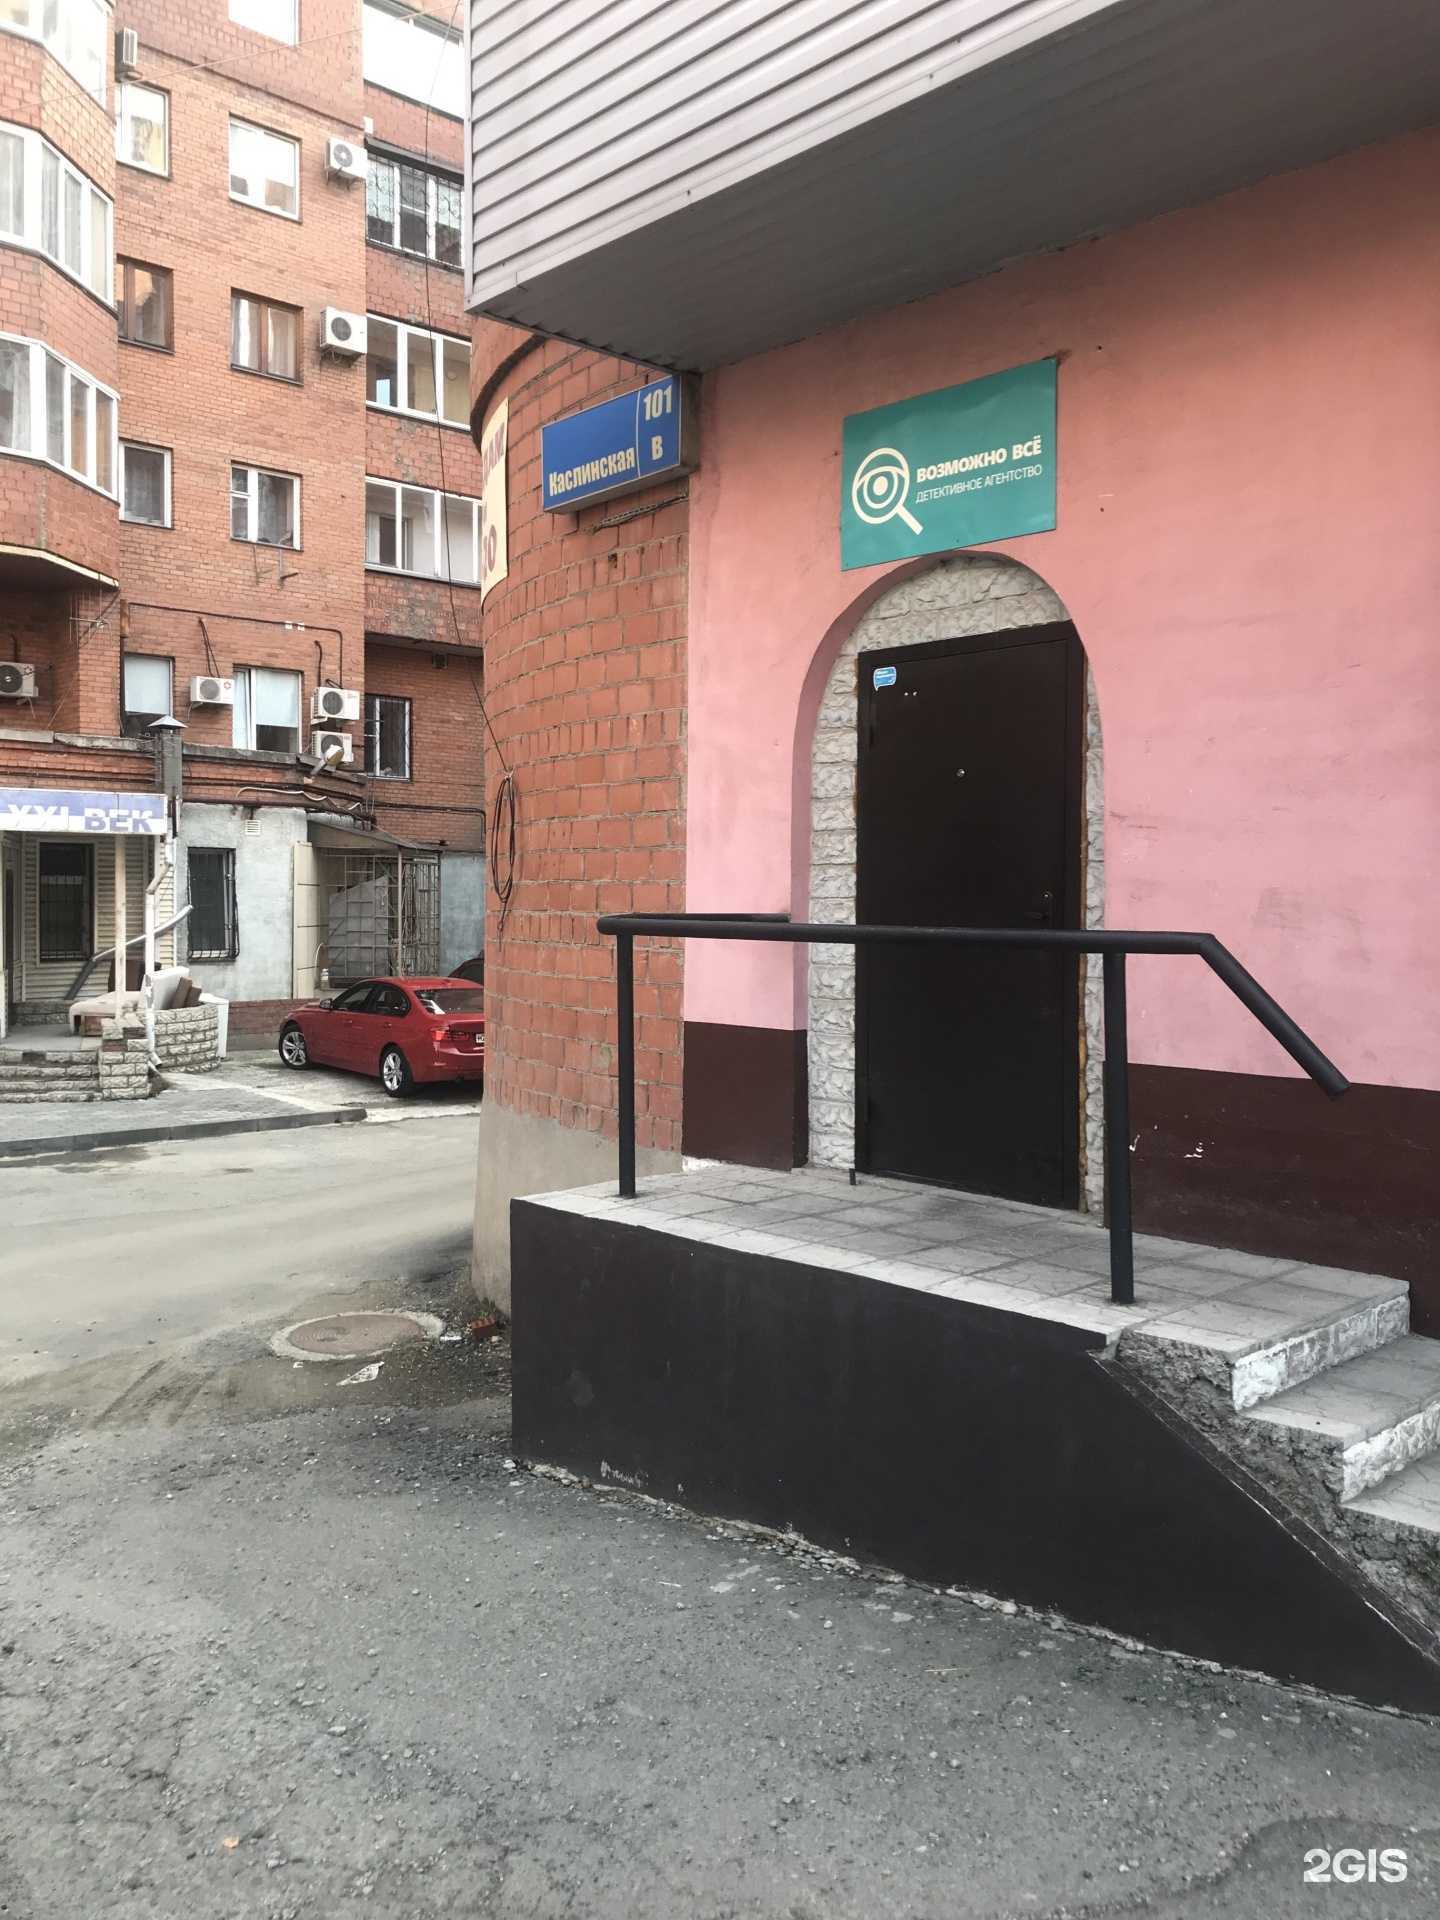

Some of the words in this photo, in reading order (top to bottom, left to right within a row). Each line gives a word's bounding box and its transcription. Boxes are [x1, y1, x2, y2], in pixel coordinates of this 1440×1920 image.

[643, 384, 673, 421] 101
[651, 435, 663, 461] В
[916, 448, 1008, 483] ВОЗМОЖНО
[1012, 435, 1042, 460] ВСЁ
[549, 446, 636, 497] Каслинская
[915, 477, 983, 504] ДЕТЕКТИВНОЕ
[984, 464, 1043, 487] АГЕНТСТВО
[7, 803, 70, 831] XXI
[83, 807, 153, 833] ВЕК
